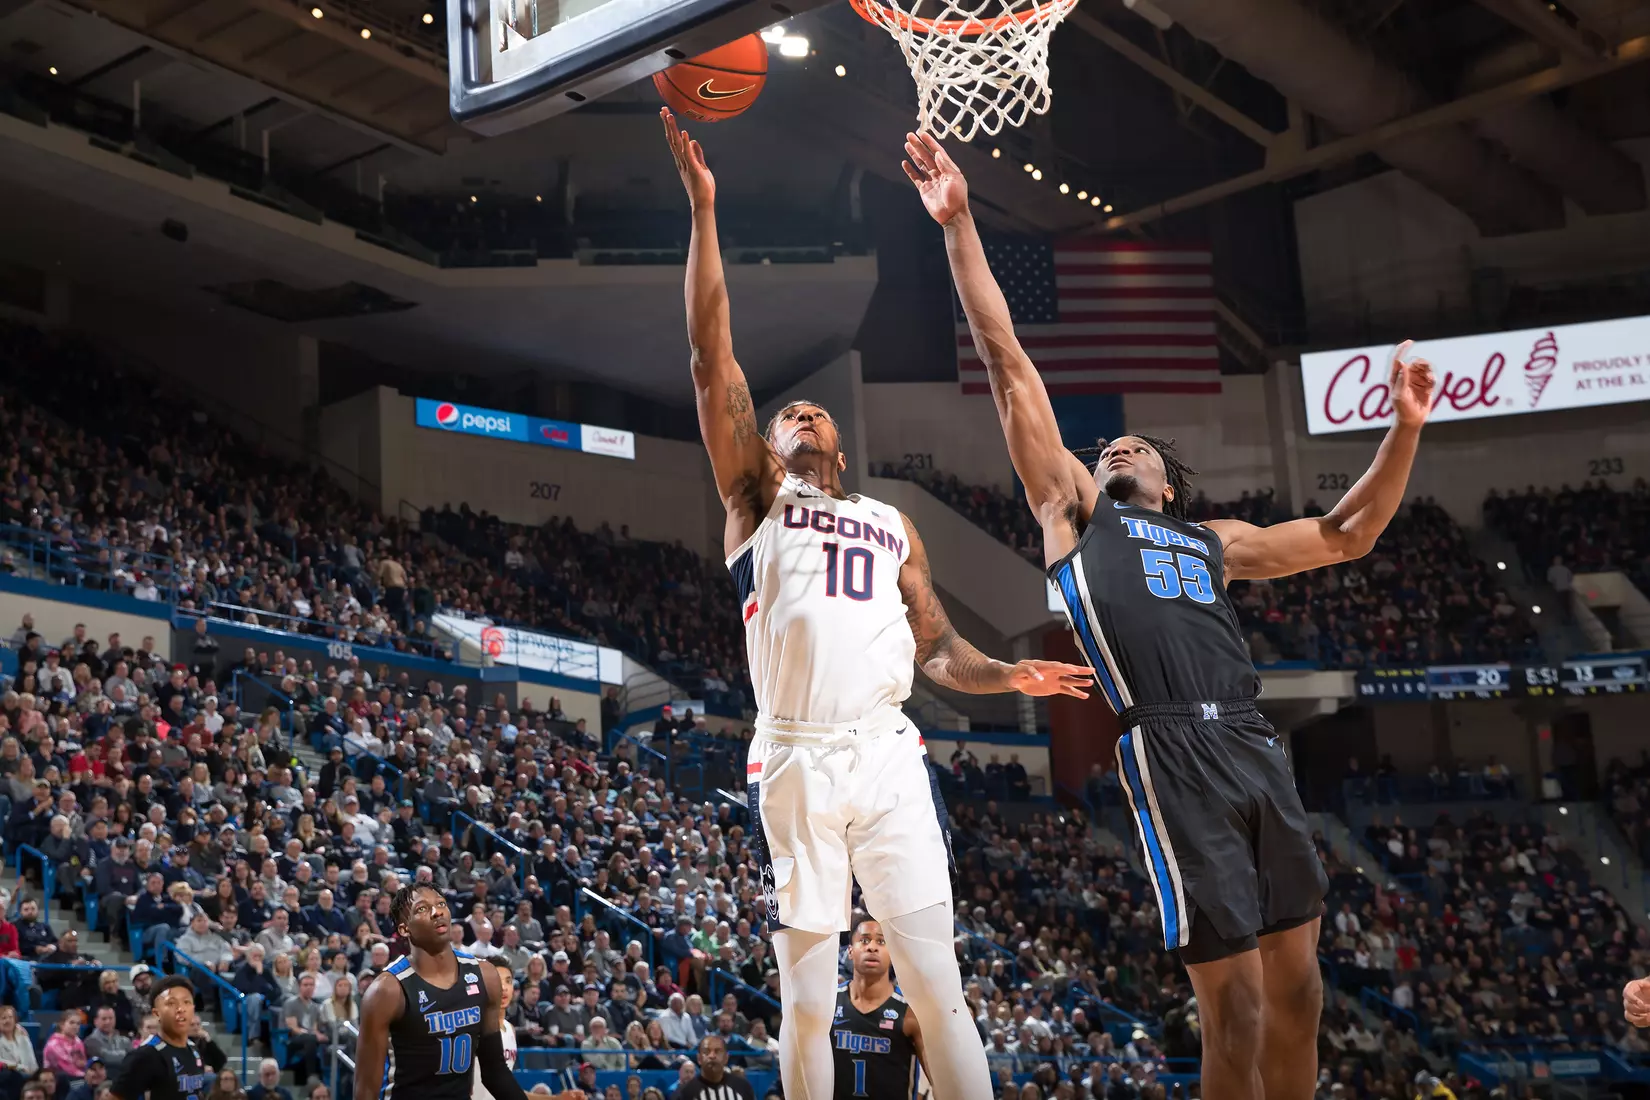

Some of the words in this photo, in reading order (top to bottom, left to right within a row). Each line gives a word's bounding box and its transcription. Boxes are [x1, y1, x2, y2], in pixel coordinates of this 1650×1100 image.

[1573, 356, 1640, 372] PROUDLY
[1324, 352, 1505, 424] Cavel
[1576, 379, 1591, 390] AT
[1597, 375, 1623, 388] THE
[462, 412, 511, 432] pepsi
[903, 453, 933, 470] 231
[1588, 456, 1624, 476] 233
[529, 481, 562, 500] 207
[1317, 474, 1350, 490] 232
[784, 504, 903, 562] UCONN
[1120, 516, 1209, 556] Tigers
[822, 541, 875, 602] 10
[1140, 548, 1216, 604] 55
[327, 644, 353, 661] 105
[1476, 669, 1500, 685] 20
[1574, 666, 1594, 682] 13
[424, 1006, 481, 1034] Tigers
[834, 1029, 891, 1054] Tigers
[435, 1033, 472, 1075] 10
[852, 1059, 869, 1097] 1
